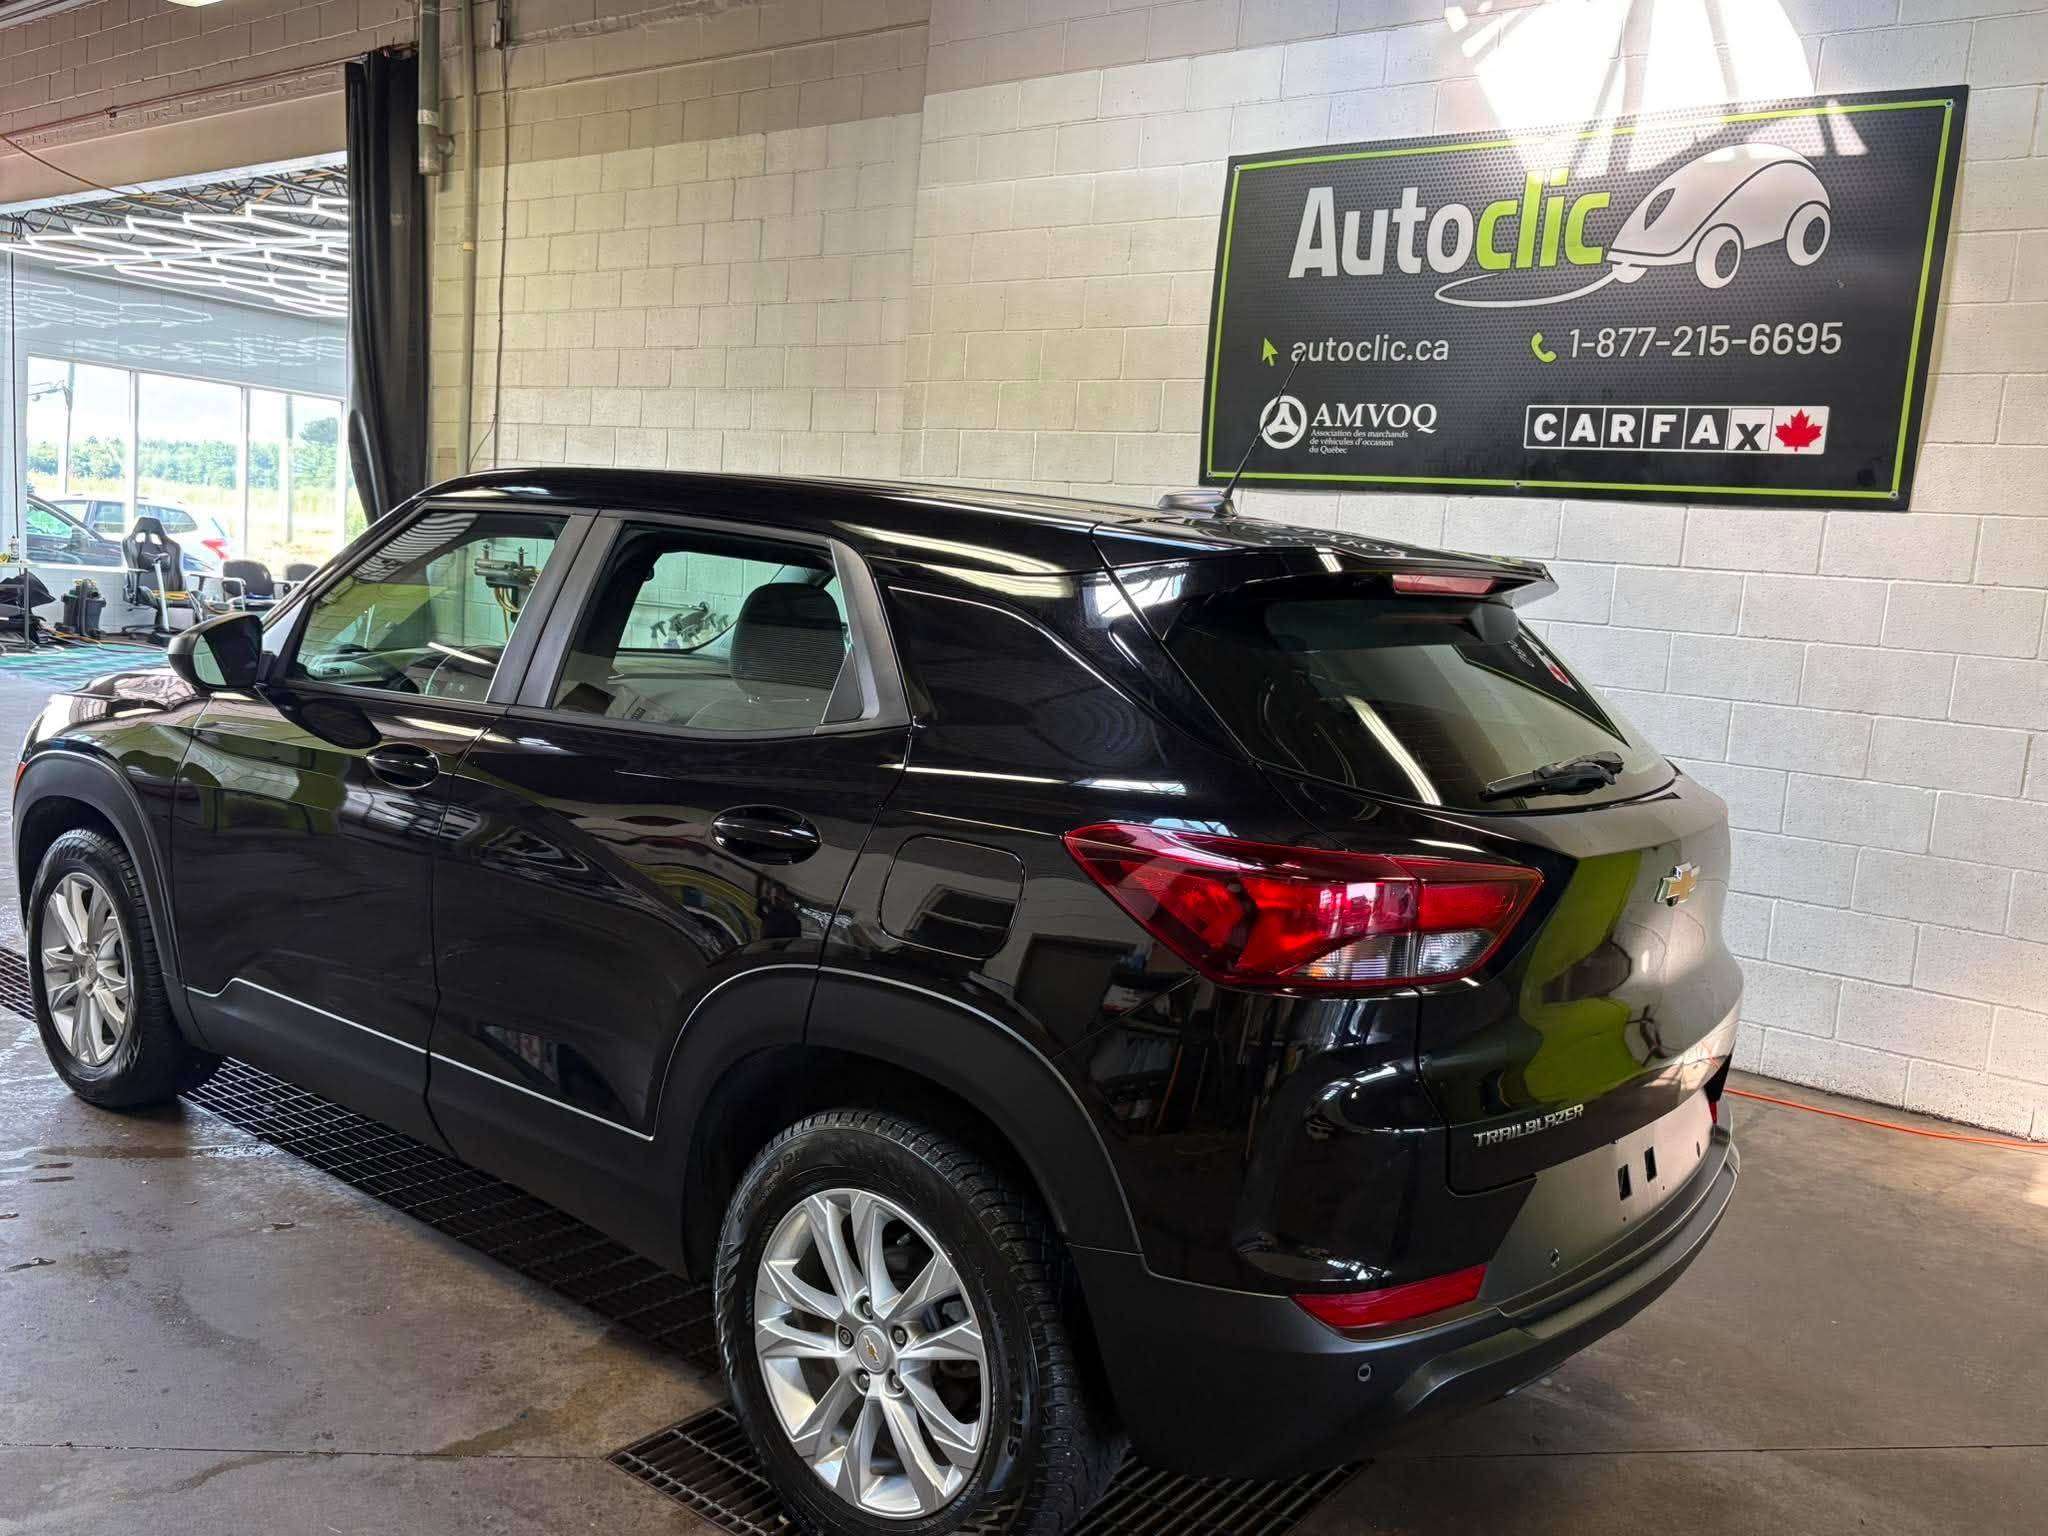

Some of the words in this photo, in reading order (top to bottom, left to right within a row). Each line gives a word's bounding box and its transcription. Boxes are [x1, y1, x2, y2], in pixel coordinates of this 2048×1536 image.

[1288, 167, 1611, 278] Autoclic
[1290, 334, 1450, 362] autoclic.ca
[1568, 322, 1844, 358] 1-877-215-6695
[1310, 402, 1438, 434] AMVOQ
[1310, 429, 1352, 437] Association
[1532, 412, 1767, 451] CARFAX
[1472, 1103, 1585, 1148] TRAILBLAZER
